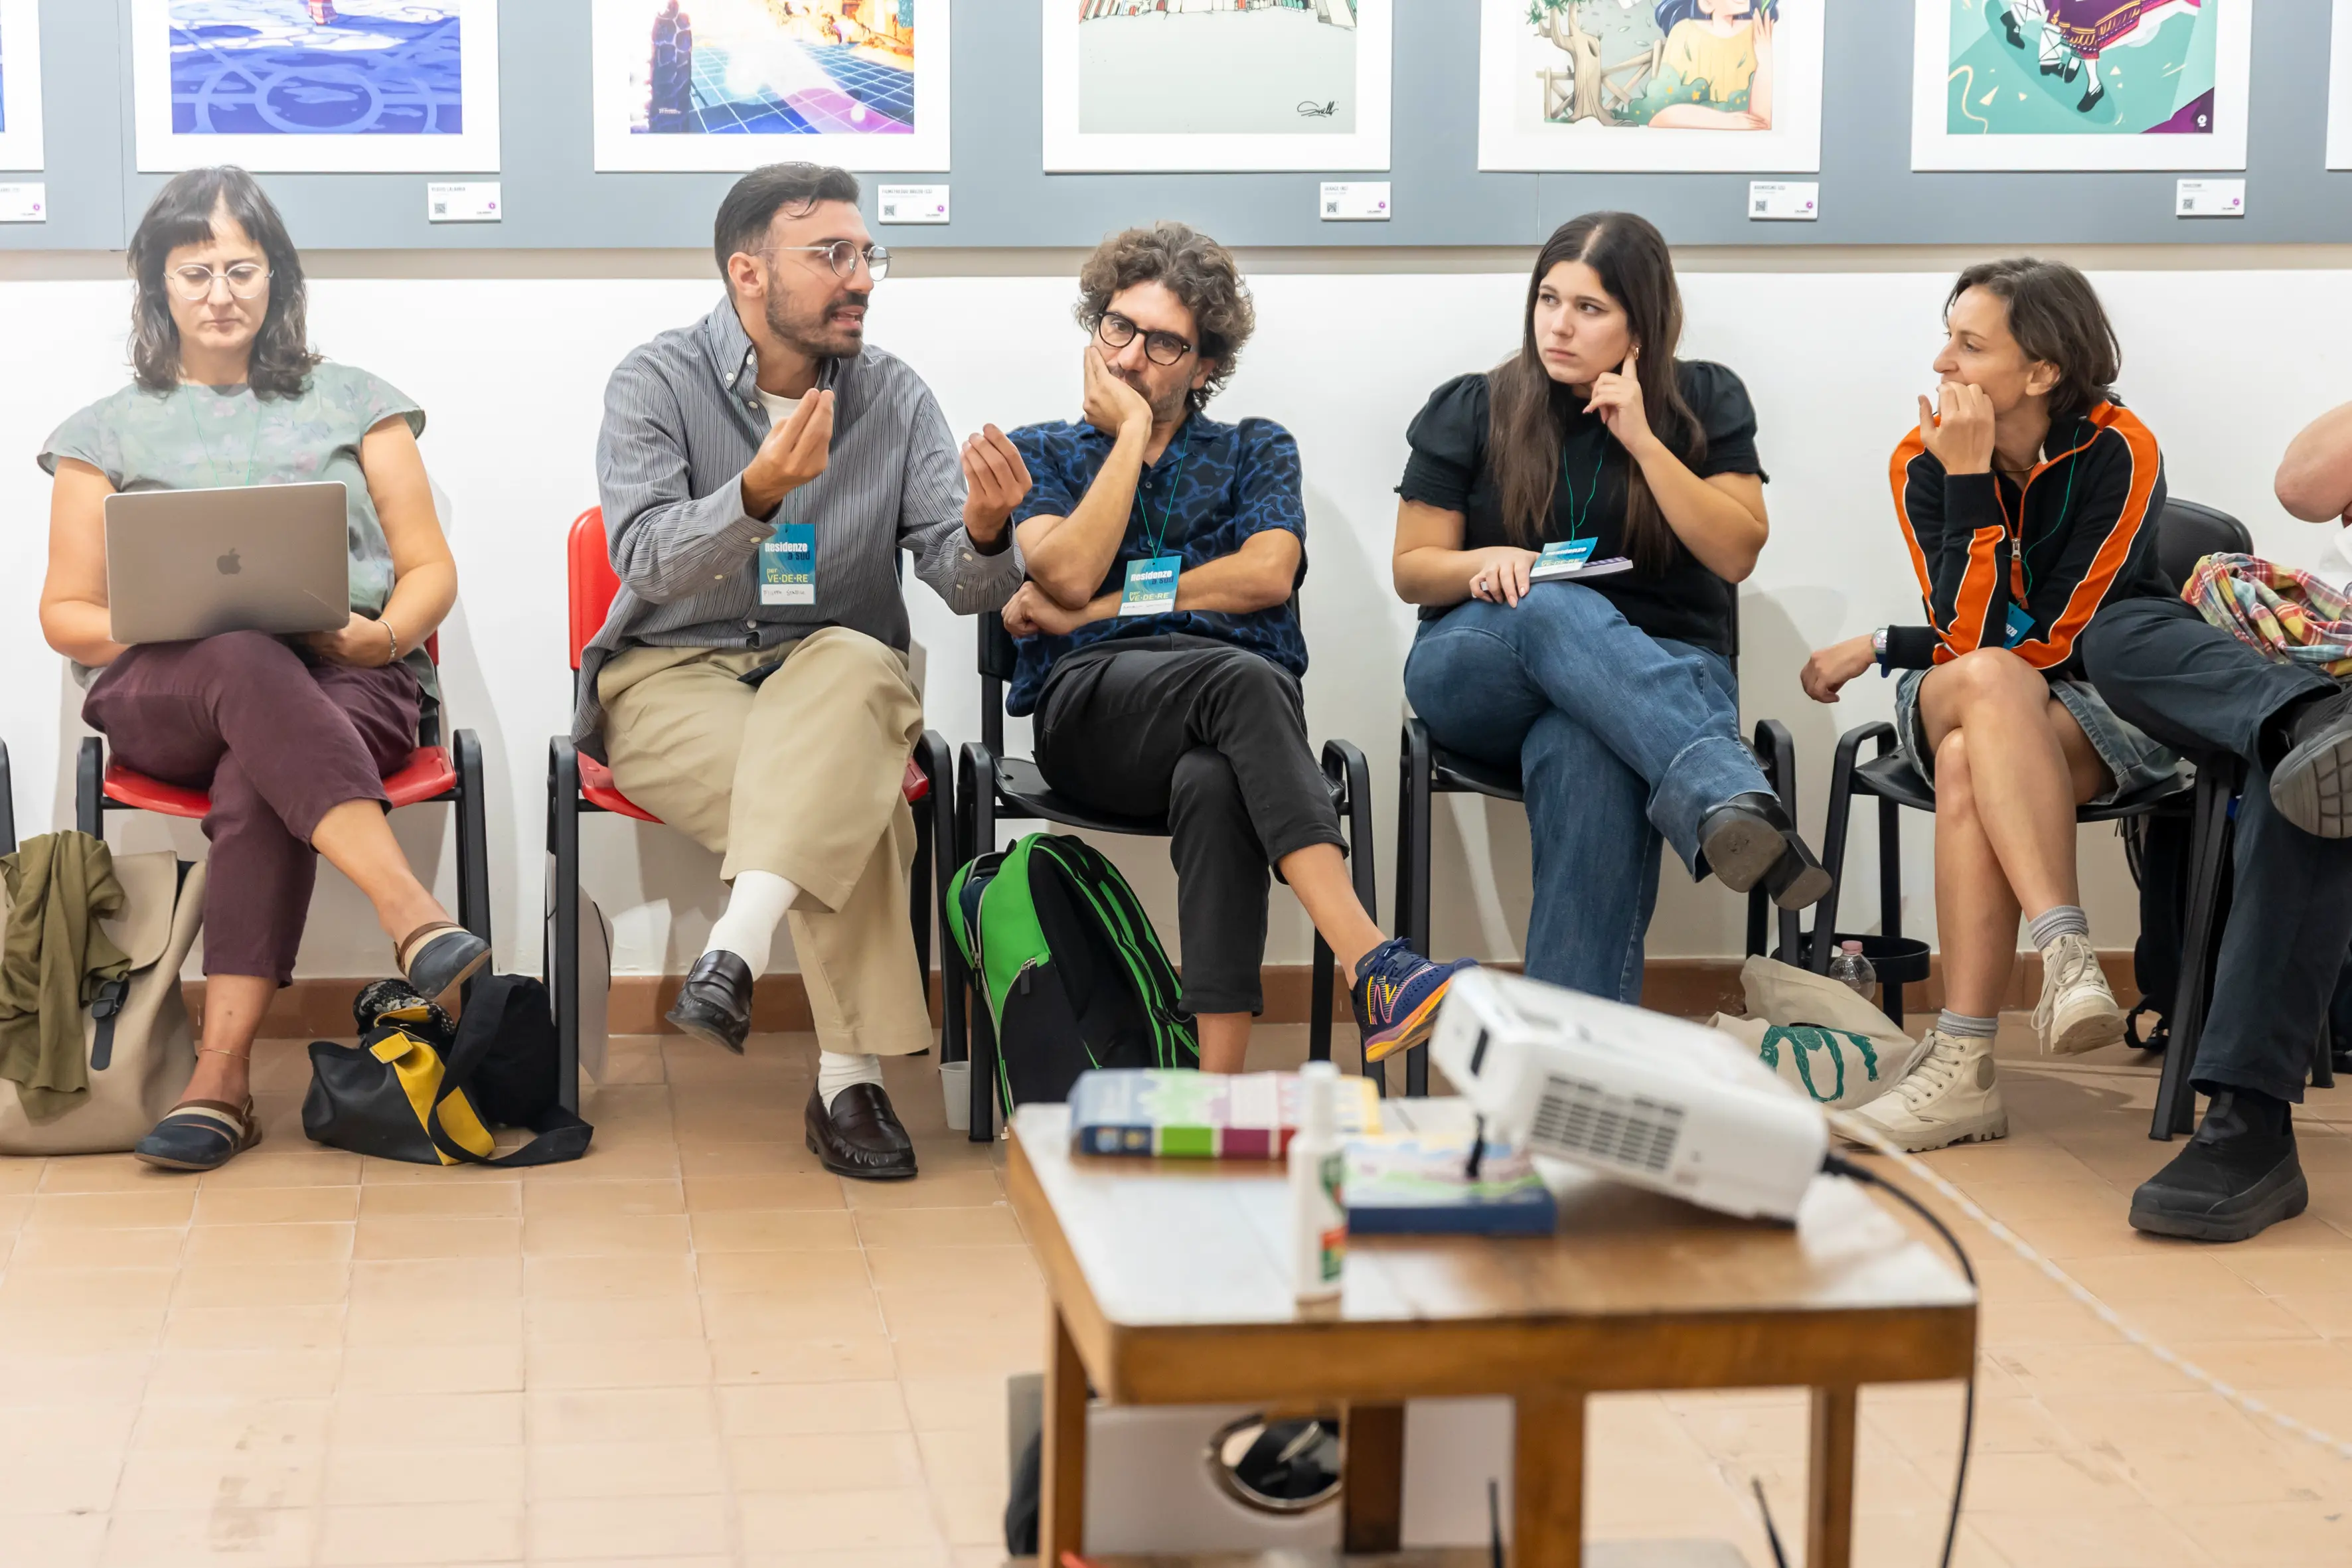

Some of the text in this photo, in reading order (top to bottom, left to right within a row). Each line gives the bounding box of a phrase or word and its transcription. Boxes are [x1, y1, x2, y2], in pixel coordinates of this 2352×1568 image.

[765, 542, 808, 552] Residenze
[795, 550, 810, 560] sud
[1131, 570, 1172, 582] Residenze
